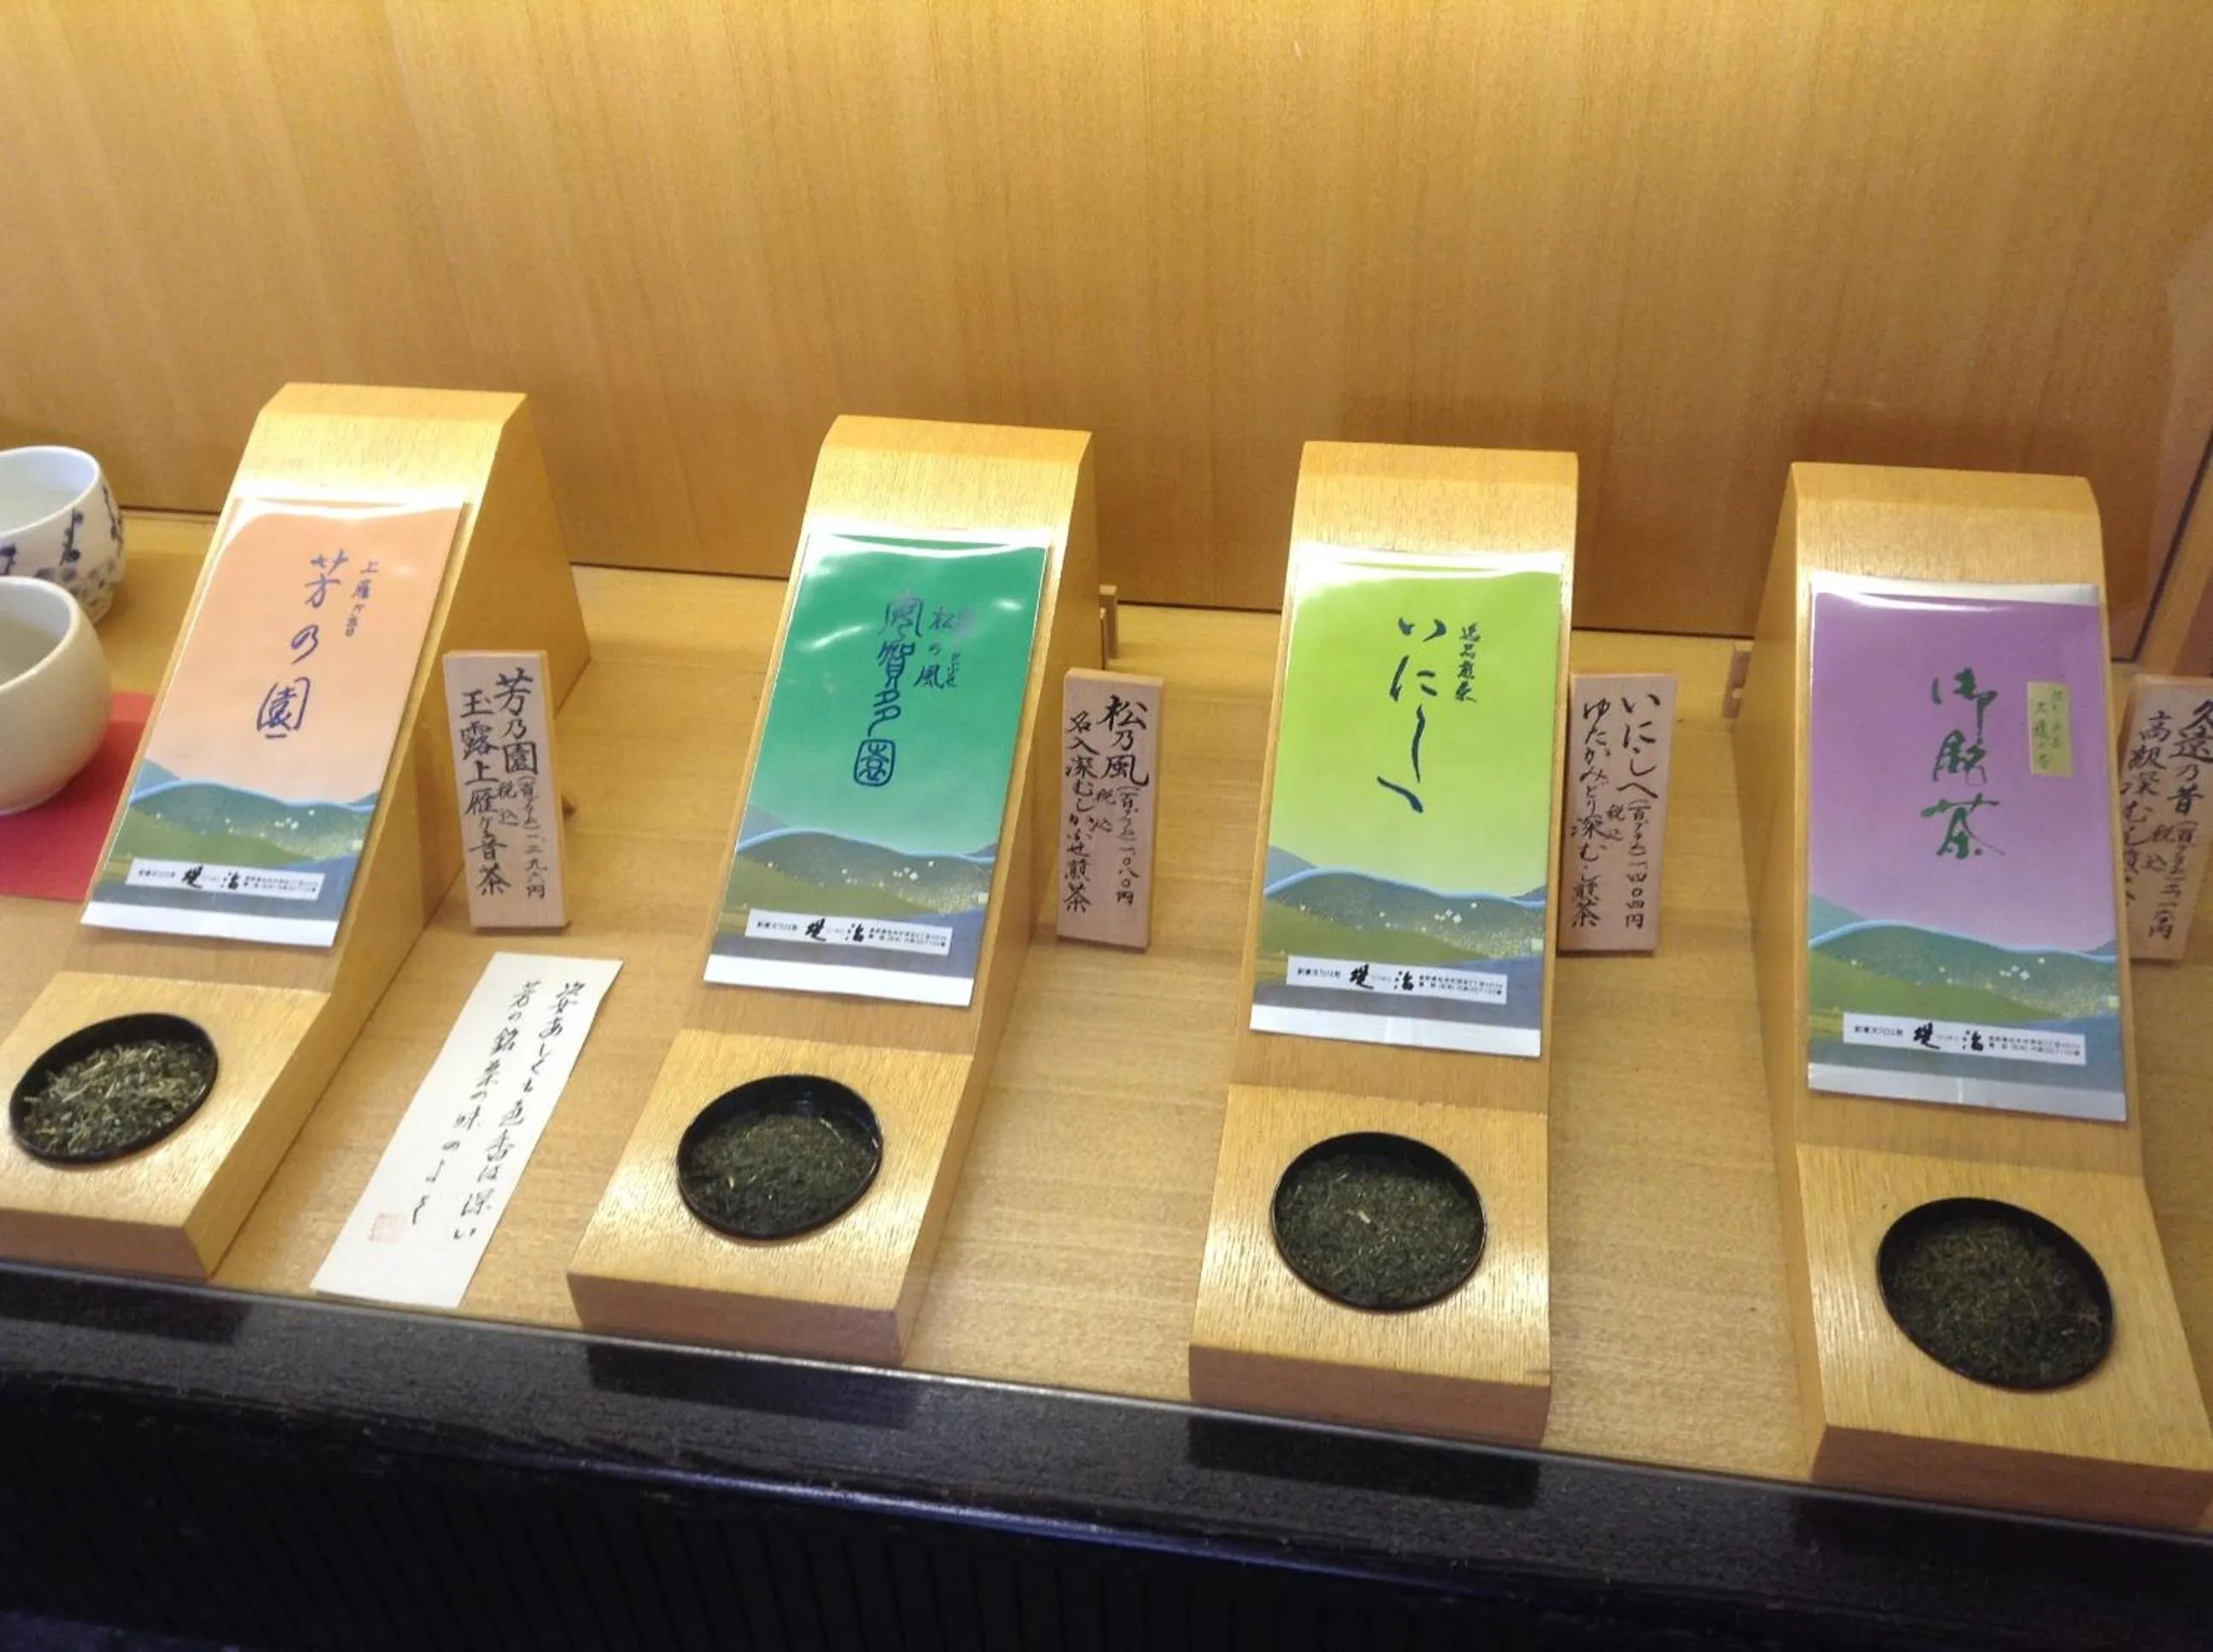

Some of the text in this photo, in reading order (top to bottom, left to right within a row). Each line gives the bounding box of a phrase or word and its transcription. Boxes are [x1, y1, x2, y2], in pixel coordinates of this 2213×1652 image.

[493, 667, 538, 775] 芳乃園
[1096, 694, 1149, 787] 松乃風
